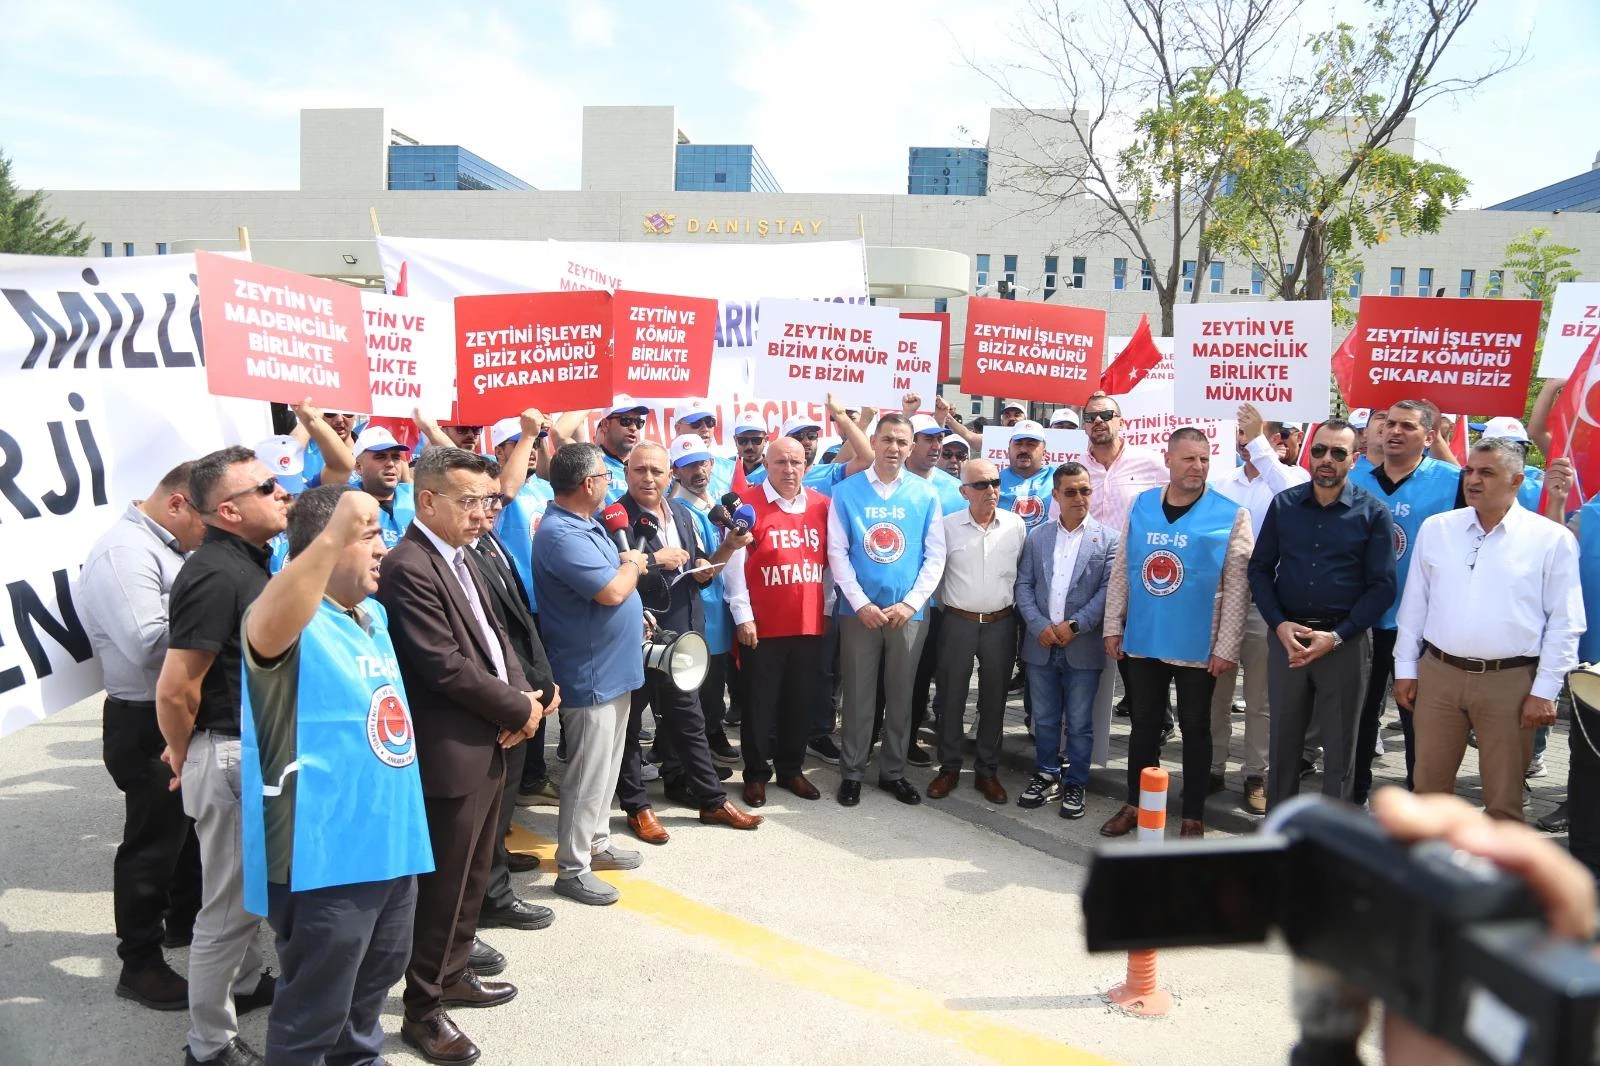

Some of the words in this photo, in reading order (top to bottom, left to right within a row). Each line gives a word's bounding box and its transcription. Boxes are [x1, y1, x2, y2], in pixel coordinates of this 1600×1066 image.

[567, 260, 607, 286] ZEYTİN
[608, 275, 622, 289] VE
[233, 278, 306, 311] ZEYTİN
[308, 294, 334, 317] VE
[224, 302, 349, 342] MADENCİLİK
[402, 314, 425, 332] VE
[629, 305, 677, 324] ZEYTİN
[679, 311, 696, 325] VE
[465, 324, 533, 348] ZEYTİNİ
[536, 323, 602, 347] İŞLEYEN
[635, 324, 686, 344] KÖMÜR
[783, 323, 846, 342] ZEYTİN
[849, 329, 873, 344] DE
[974, 323, 1032, 341] ZEYTİNİ
[1034, 326, 1094, 348] İŞLEYEN
[1202, 316, 1266, 336] ZEYTİN
[1269, 320, 1294, 336] VE
[1561, 321, 1600, 337] BİZ
[248, 329, 335, 363] BİRLİKTE
[898, 340, 918, 354] DE
[1192, 338, 1308, 358] MADENCİLİK
[1366, 326, 1440, 345] ZEYTİNİ
[1442, 327, 1522, 350] İŞLEYEN
[473, 347, 517, 369] BİZİZ
[520, 341, 596, 365] KÖMÜRÜ
[631, 343, 689, 363] BİRLİKTE
[767, 339, 817, 360] BİZİM
[821, 344, 889, 365] KÖMÜR
[978, 338, 1017, 356] BİZİZ
[1019, 343, 1087, 364] KÖMÜRÜ
[1371, 344, 1418, 362] BİZİZ
[1421, 347, 1511, 367] KÖMÜRÜ
[246, 356, 341, 388] MÜMKÜN
[368, 353, 417, 375] LİKTE
[627, 364, 690, 382] MÜMKÜN
[788, 364, 811, 379] DE
[815, 363, 865, 384] BİZİM
[976, 357, 1048, 377] ÇIKARAN
[1050, 363, 1088, 381] BİZİZ
[1210, 360, 1289, 380] BİRLİKTE
[473, 368, 554, 395] ÇIKARAN
[557, 361, 599, 382] BİZİZ
[1369, 367, 1458, 385] ÇIKARAN
[1461, 368, 1512, 387] BİZİZ
[1206, 382, 1293, 402] MÜMKÜN
[864, 505, 906, 521] TES-İŞ
[768, 524, 820, 553] TES-İŞ
[1146, 531, 1189, 549] TES-İŞ
